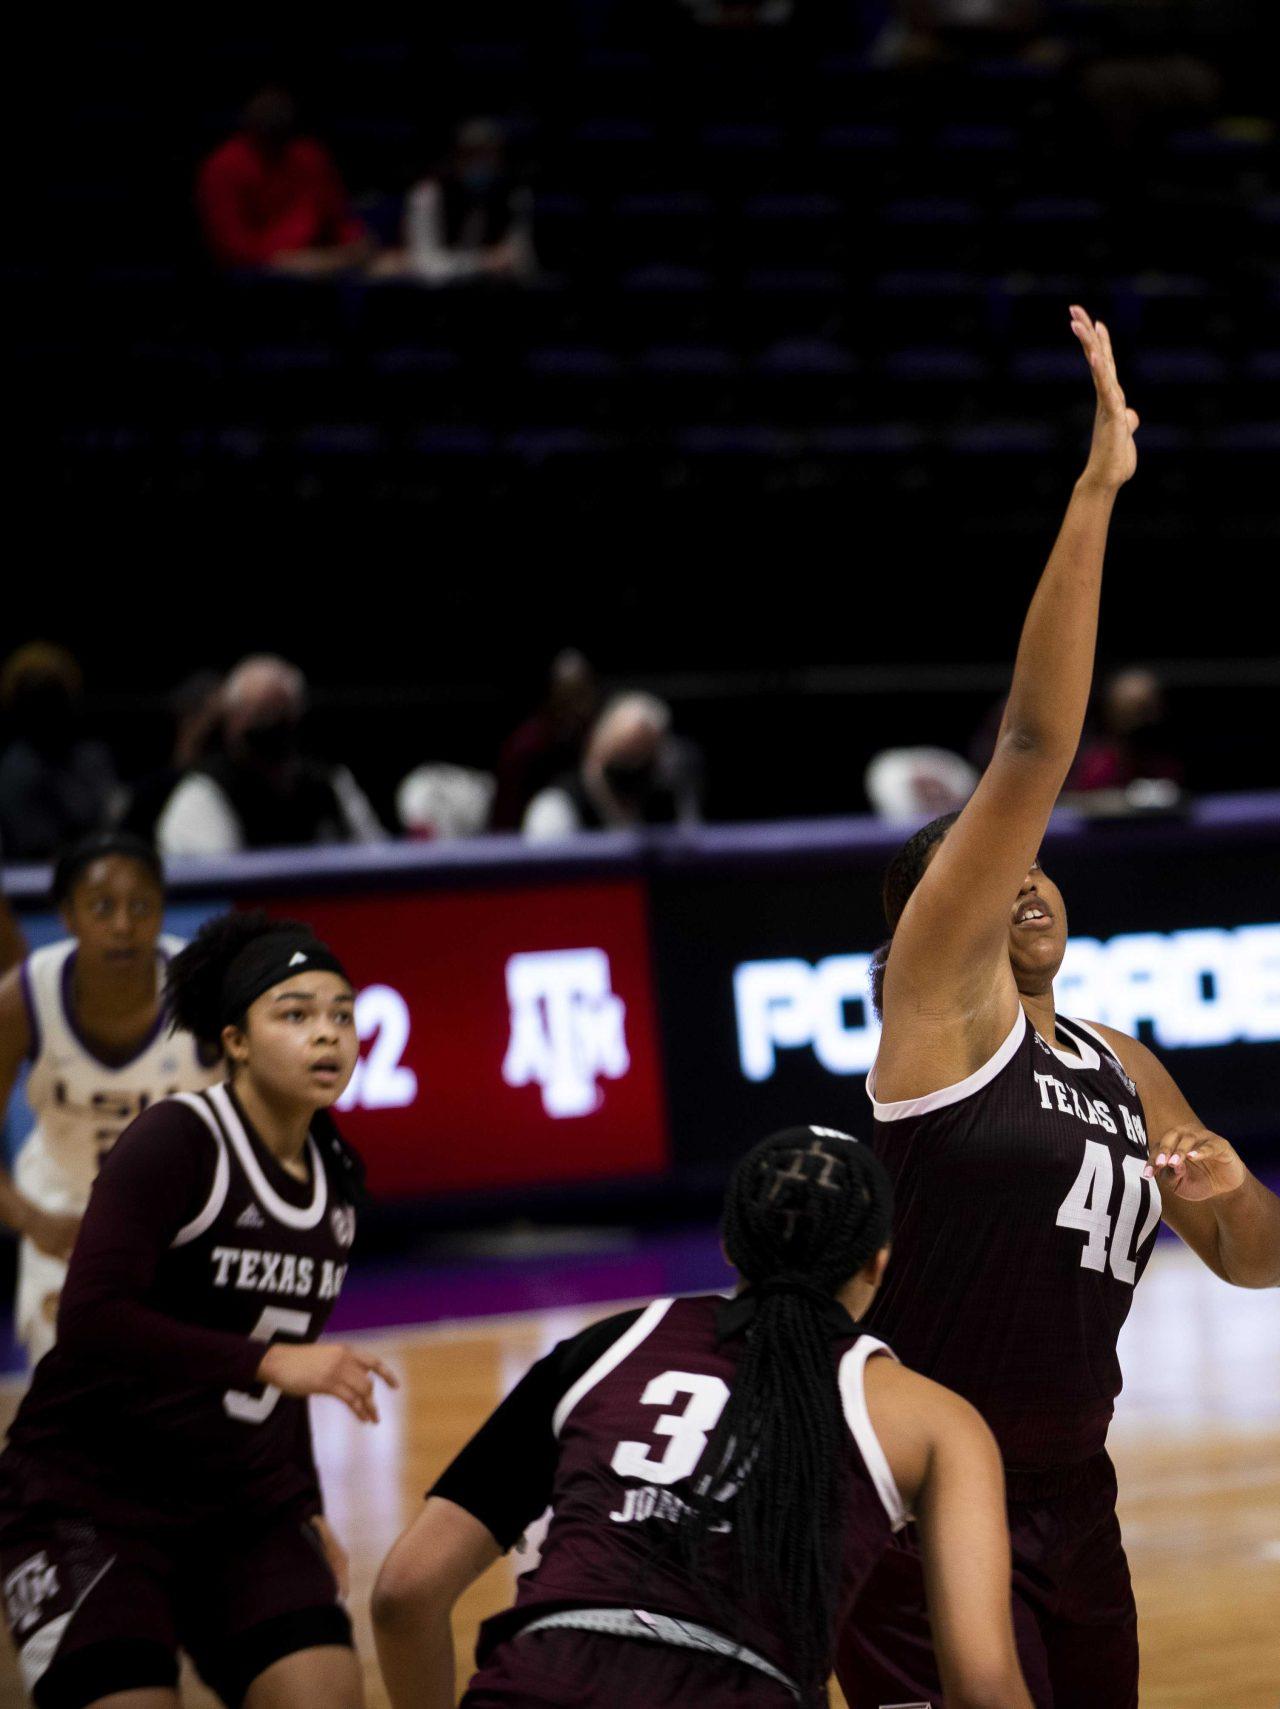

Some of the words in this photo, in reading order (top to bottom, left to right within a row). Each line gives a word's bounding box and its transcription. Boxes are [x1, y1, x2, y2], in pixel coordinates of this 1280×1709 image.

[335, 984, 418, 1112] 2
[211, 1246, 315, 1297] TEXAS
[1056, 1139, 1163, 1285] 40
[610, 1370, 731, 1485] 3
